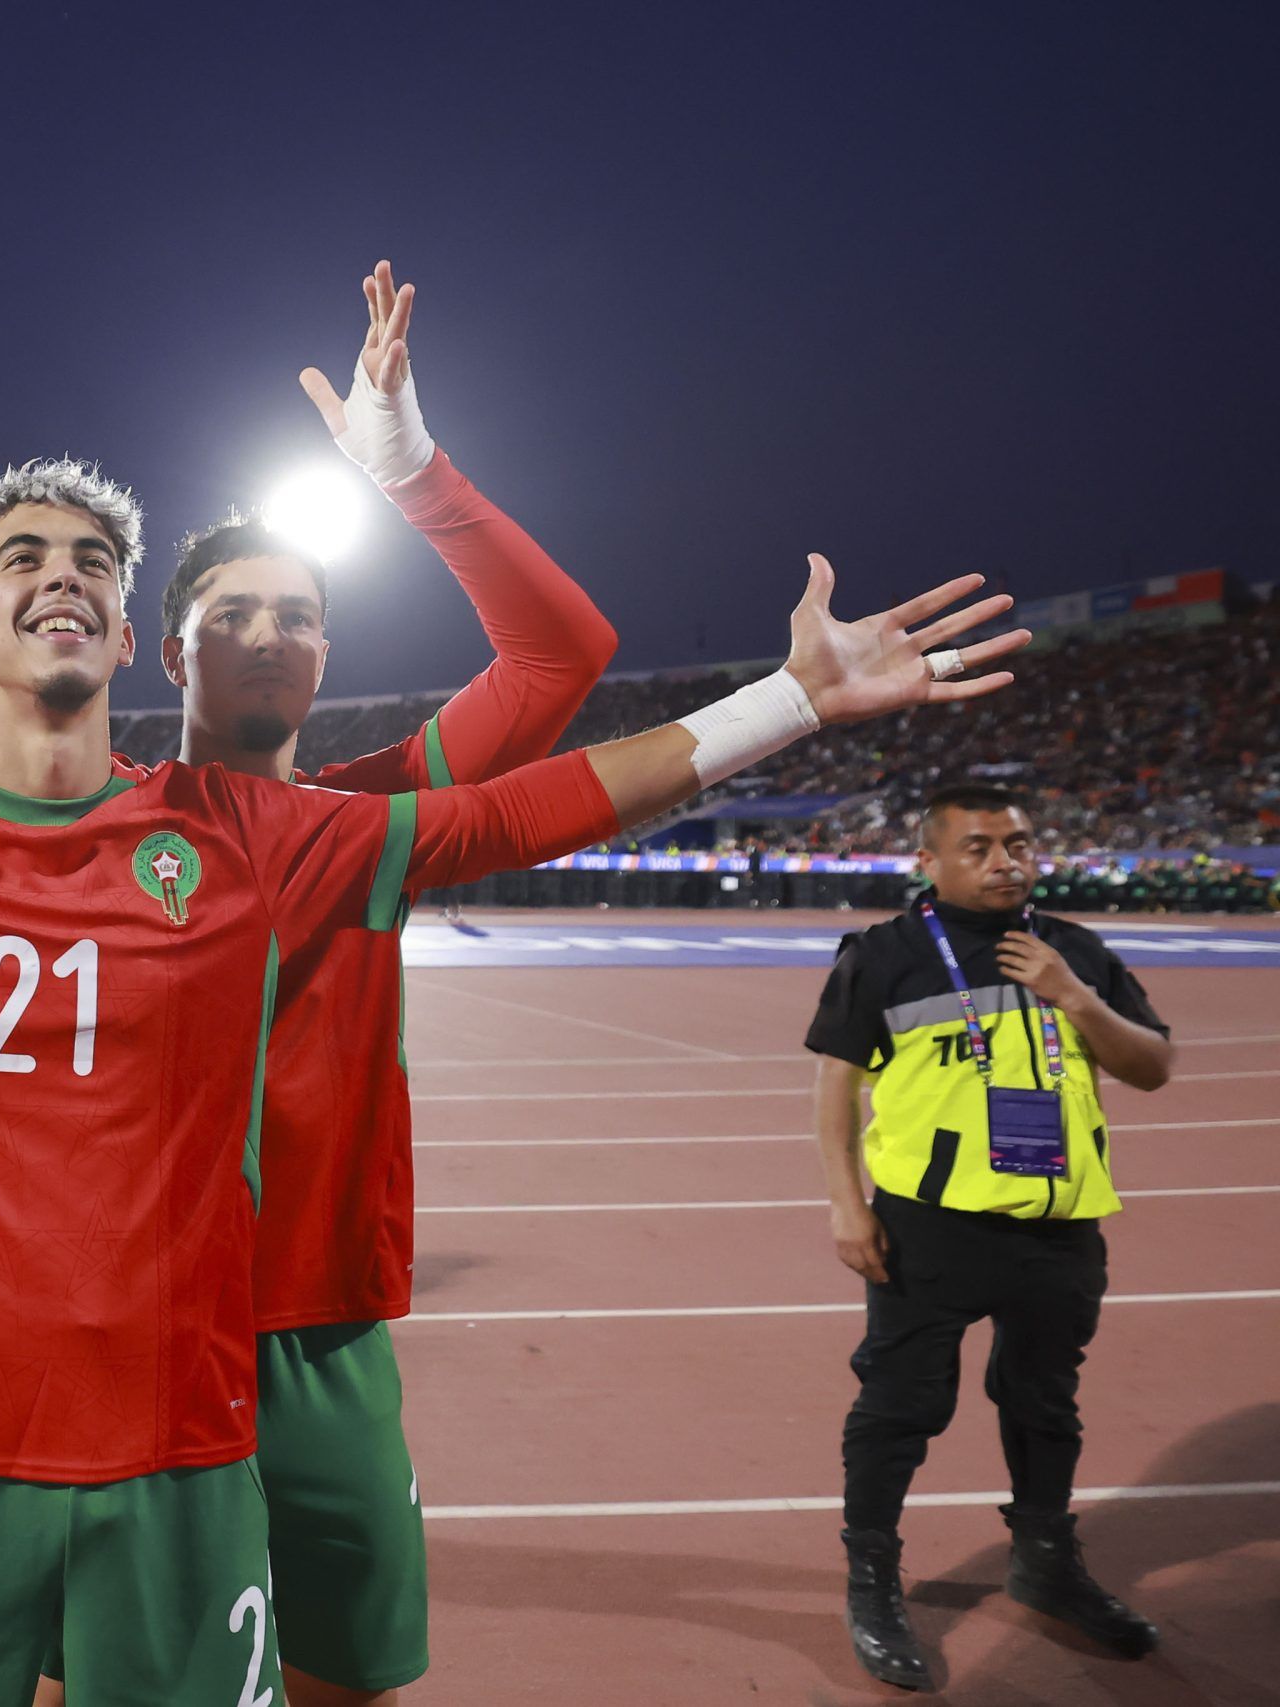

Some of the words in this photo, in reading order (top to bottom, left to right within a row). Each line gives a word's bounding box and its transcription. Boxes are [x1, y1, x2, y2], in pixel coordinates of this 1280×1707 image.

[581, 854, 610, 870] VISA
[651, 856, 682, 871] VISA
[229, 1552, 276, 1707] 2
